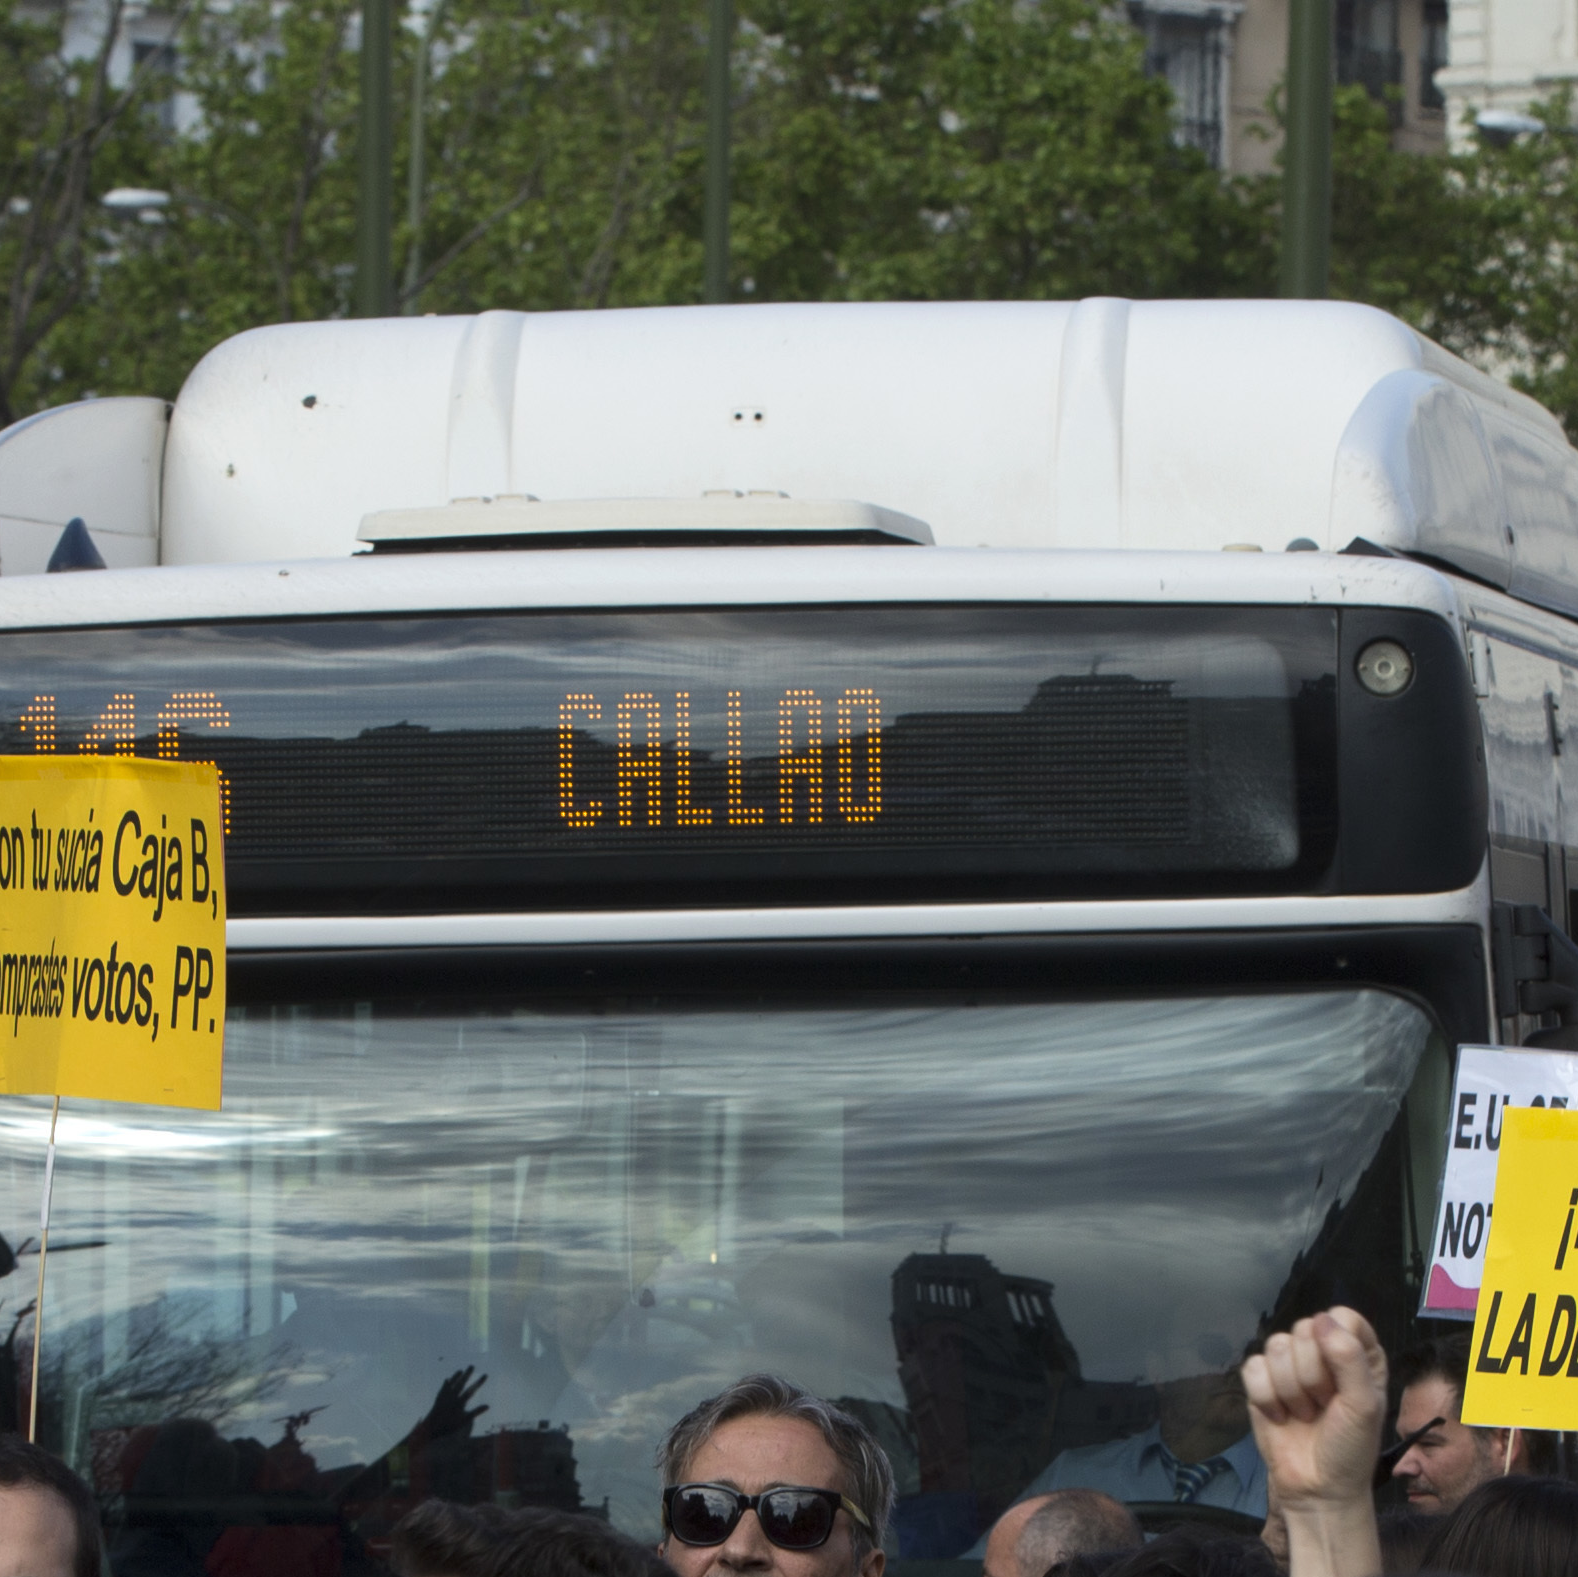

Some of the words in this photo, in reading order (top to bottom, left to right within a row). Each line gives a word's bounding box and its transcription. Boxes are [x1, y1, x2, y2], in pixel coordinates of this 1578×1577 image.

[558, 687, 883, 828] CALLAO
[30, 807, 51, 891] tu
[112, 809, 183, 922] Caja
[191, 817, 219, 921] B,
[72, 941, 159, 1042] votos,
[170, 945, 216, 1034] PP.
[1475, 1290, 1538, 1376] LA
